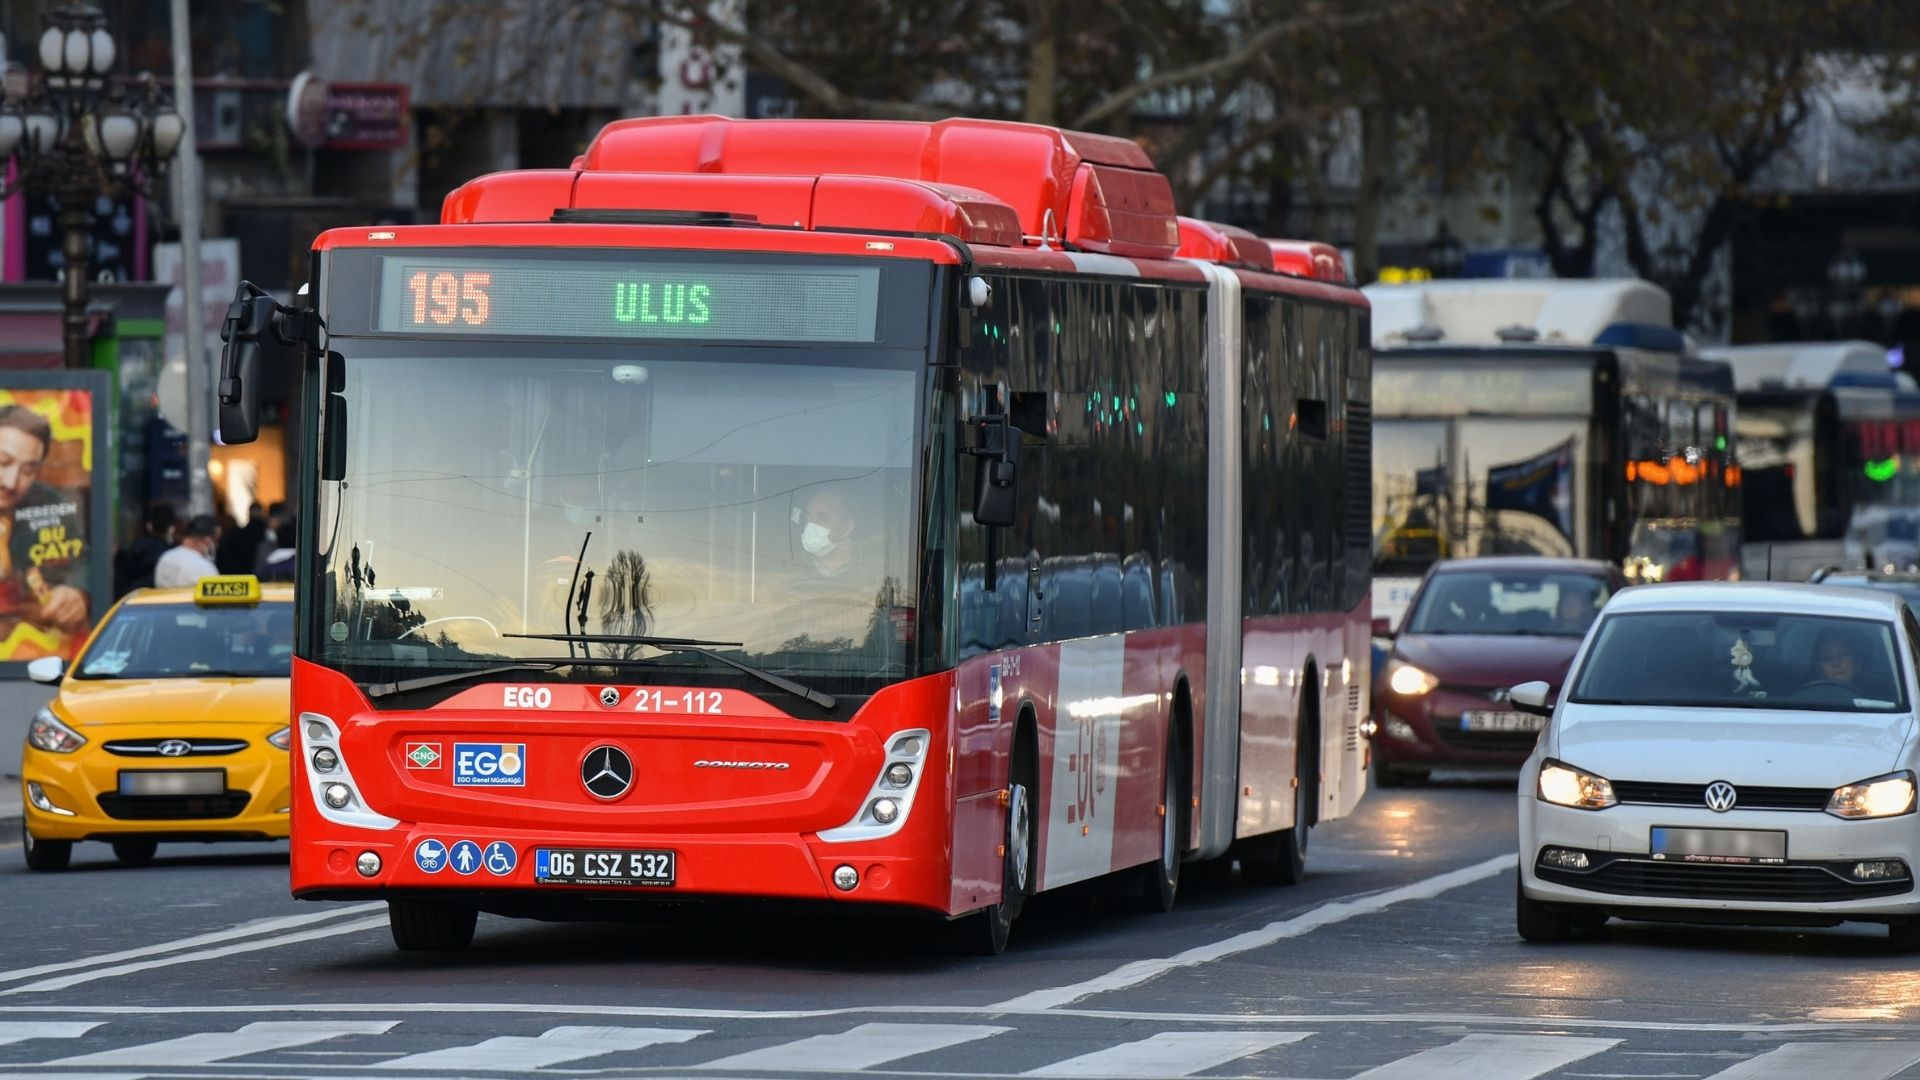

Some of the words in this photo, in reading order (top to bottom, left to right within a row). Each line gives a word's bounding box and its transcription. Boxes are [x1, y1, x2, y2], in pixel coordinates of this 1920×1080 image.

[410, 271, 491, 325] 195
[615, 281, 710, 323] ULUS
[15, 502, 77, 521] NEREDEN
[39, 525, 66, 544] BU
[28, 538, 83, 567] ÇAY?
[503, 687, 552, 709] EGO
[635, 689, 722, 714] 21-112
[413, 751, 435, 760] CNG
[457, 751, 521, 775] EGO
[693, 760, 790, 770] CONECTO
[550, 853, 575, 876] 06
[584, 853, 622, 877] CSZ
[630, 854, 668, 878] 532
